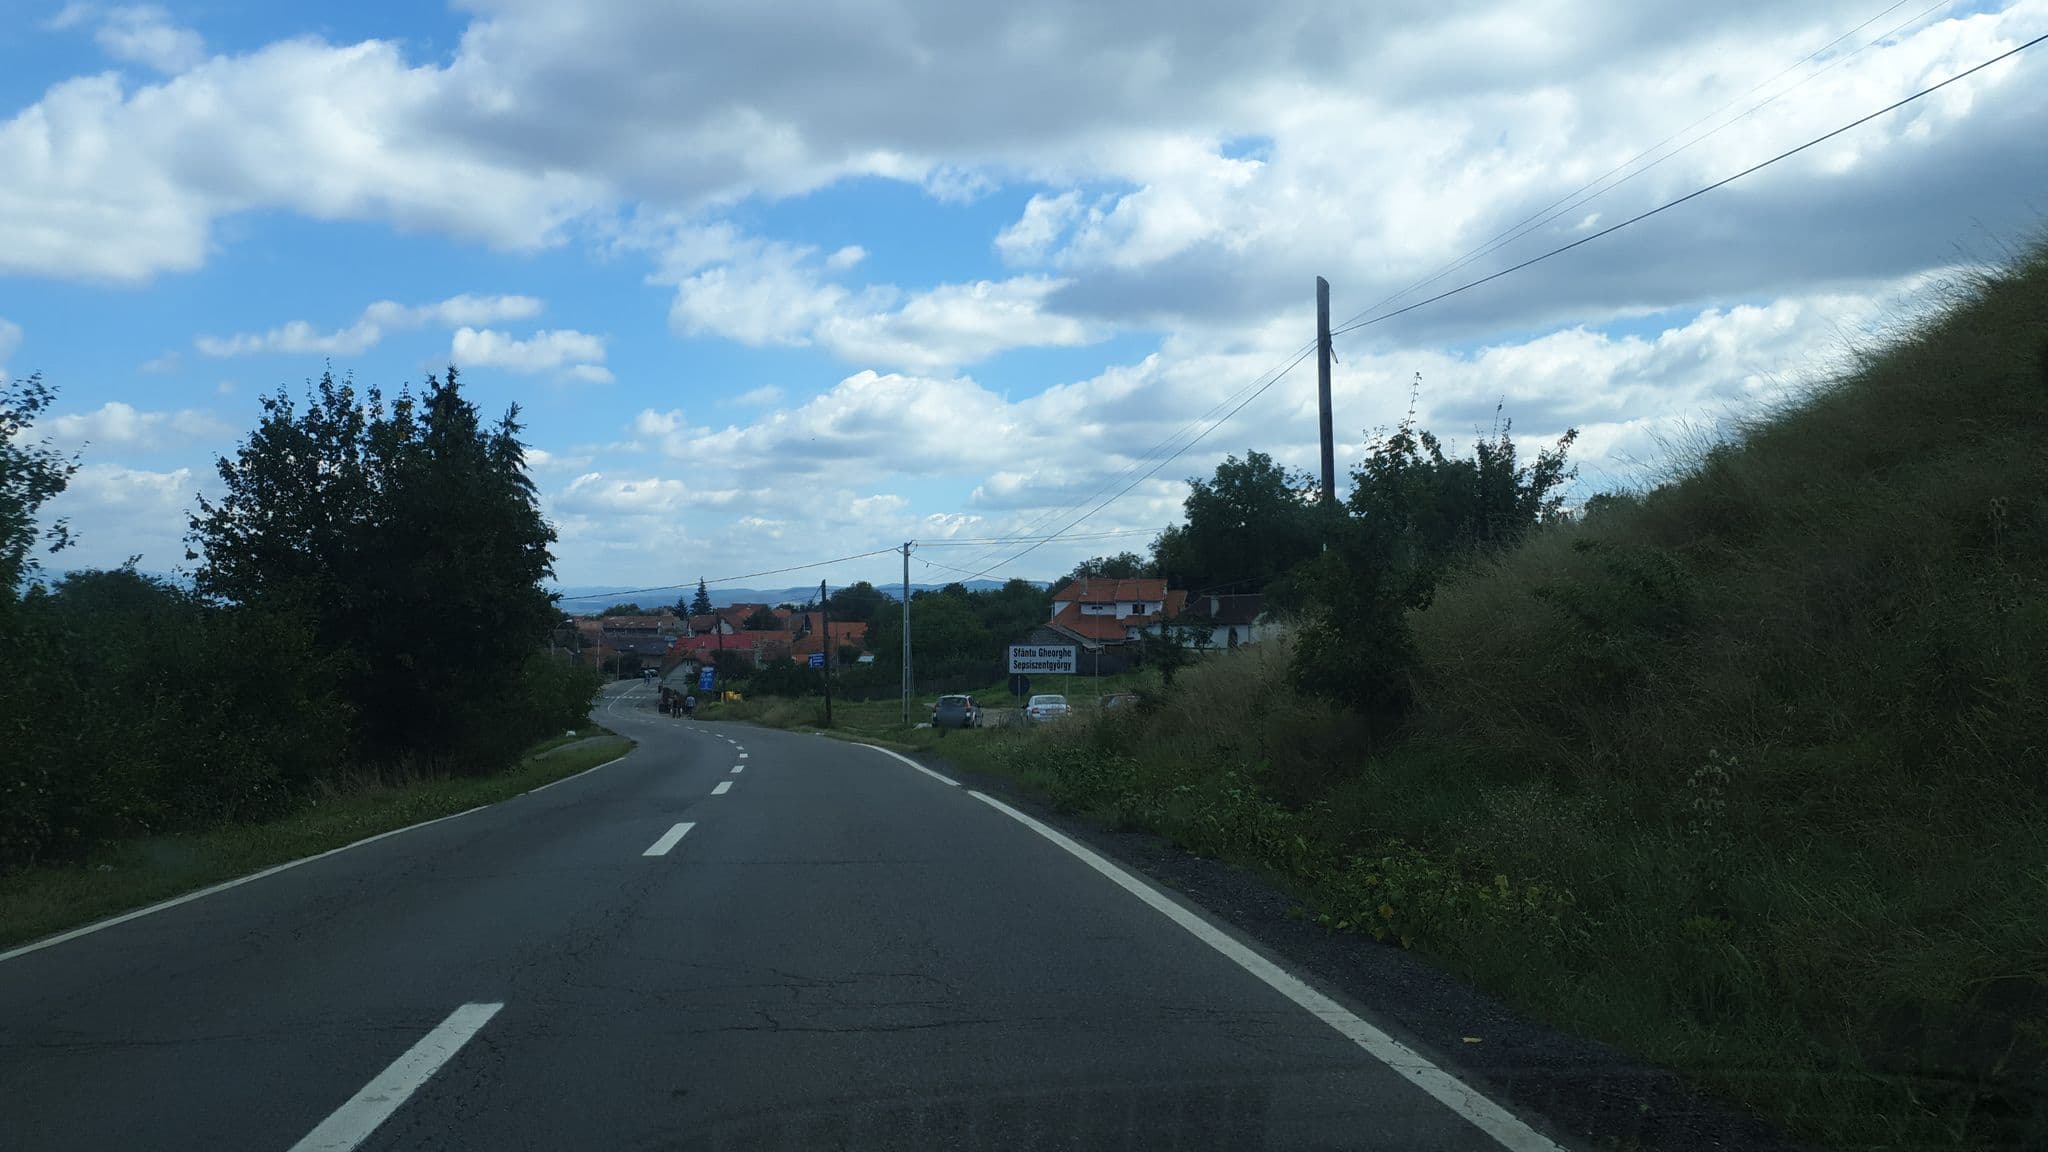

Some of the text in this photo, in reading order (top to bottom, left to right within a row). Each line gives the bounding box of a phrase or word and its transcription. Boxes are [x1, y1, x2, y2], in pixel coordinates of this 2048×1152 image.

[1013, 647, 1072, 659] Sfântu Gheorghe
[1013, 660, 1072, 671] Sepsiszentgyörgy
